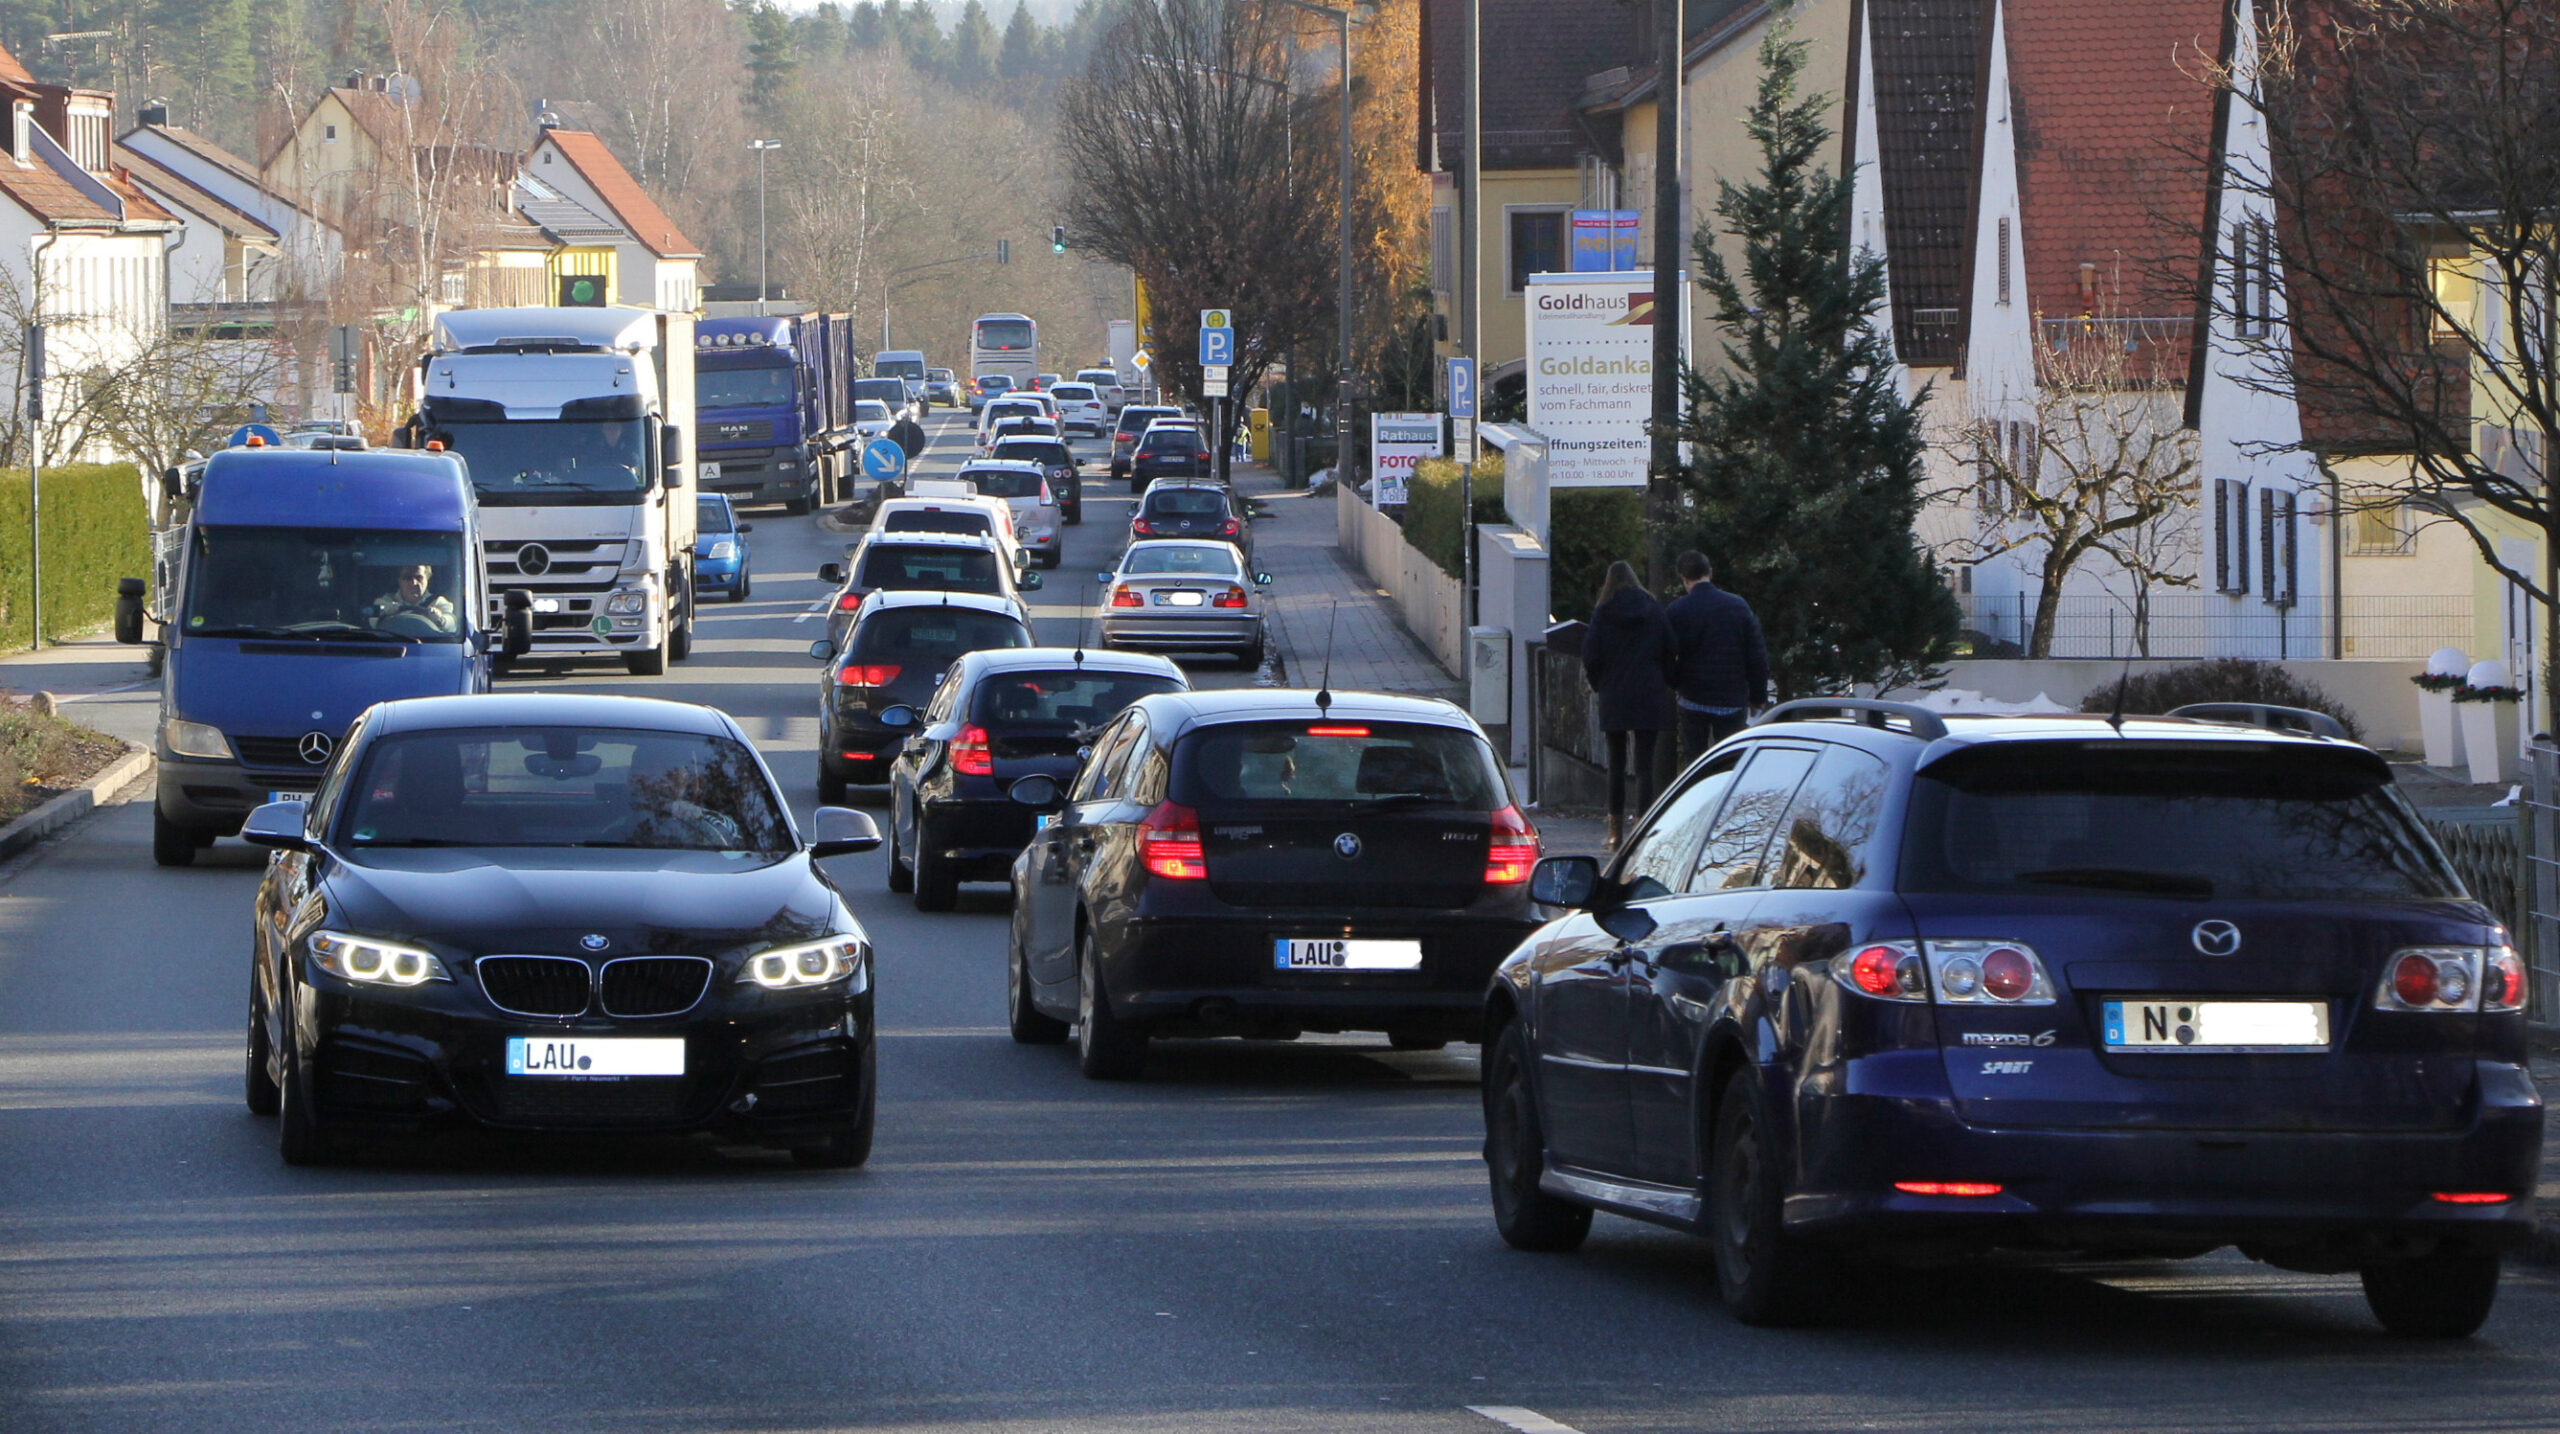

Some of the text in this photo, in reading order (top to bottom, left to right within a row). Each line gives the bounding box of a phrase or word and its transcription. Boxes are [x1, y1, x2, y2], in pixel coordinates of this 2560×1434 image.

[1538, 293, 1627, 310] Goldhaus
[1208, 332, 1226, 361] P
[1540, 354, 1651, 376] Goldanka
[1454, 365, 1468, 409] P
[1540, 382, 1652, 395] schnell, fair, diskret
[1540, 399, 1632, 410] vom Fachmann
[1380, 430, 1433, 441] Rathaus
[1551, 438, 1647, 452] ffnungszeiten:
[1549, 459, 1576, 469] ontag
[1584, 457, 1626, 466] Mittwoch
[704, 465, 716, 477] A
[1561, 470, 1584, 479] 10.00
[1593, 470, 1616, 479] 18.00
[1618, 470, 1634, 478] Uhr
[598, 618, 607, 633] L
[1290, 942, 1332, 965] LAU
[2110, 1006, 2168, 1041] D N
[526, 1043, 575, 1070] LAU
[1981, 1061, 2034, 1075] SPORT
